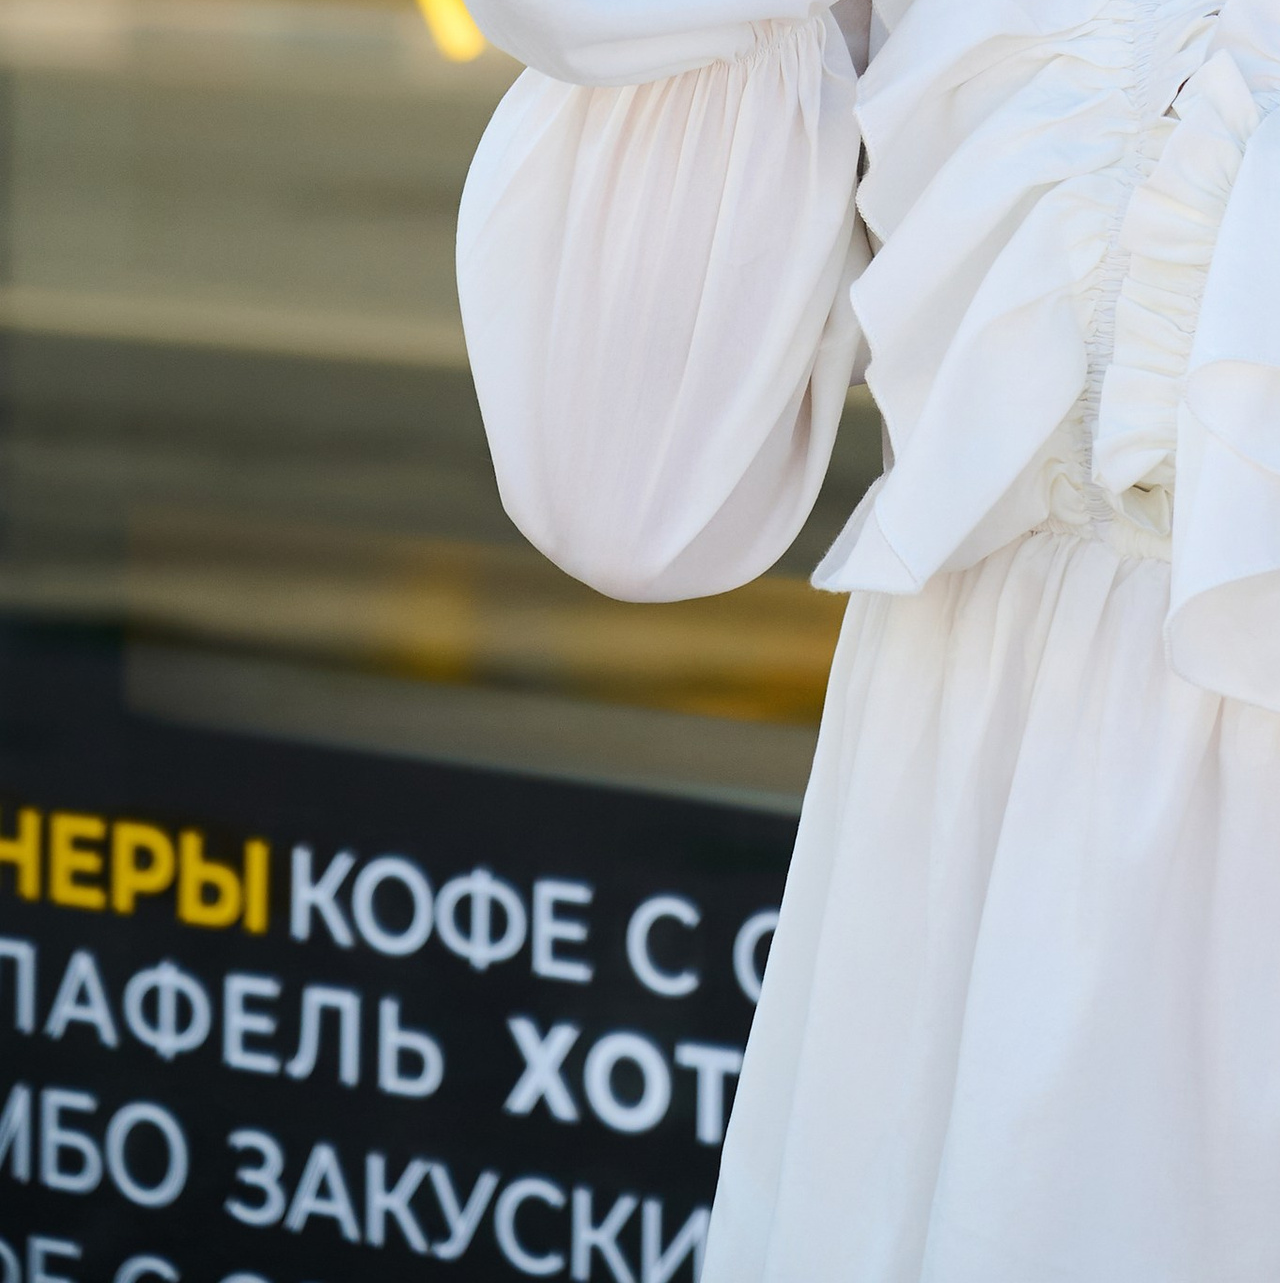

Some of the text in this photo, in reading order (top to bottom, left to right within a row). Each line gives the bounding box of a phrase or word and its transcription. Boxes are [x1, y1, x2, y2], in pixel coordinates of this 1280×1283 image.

[288, 843, 596, 984] КОФЕ
[623, 892, 702, 1000] С
[502, 1013, 745, 1148] ХОТ
[222, 1127, 714, 1283] ЗАКУСКИ
